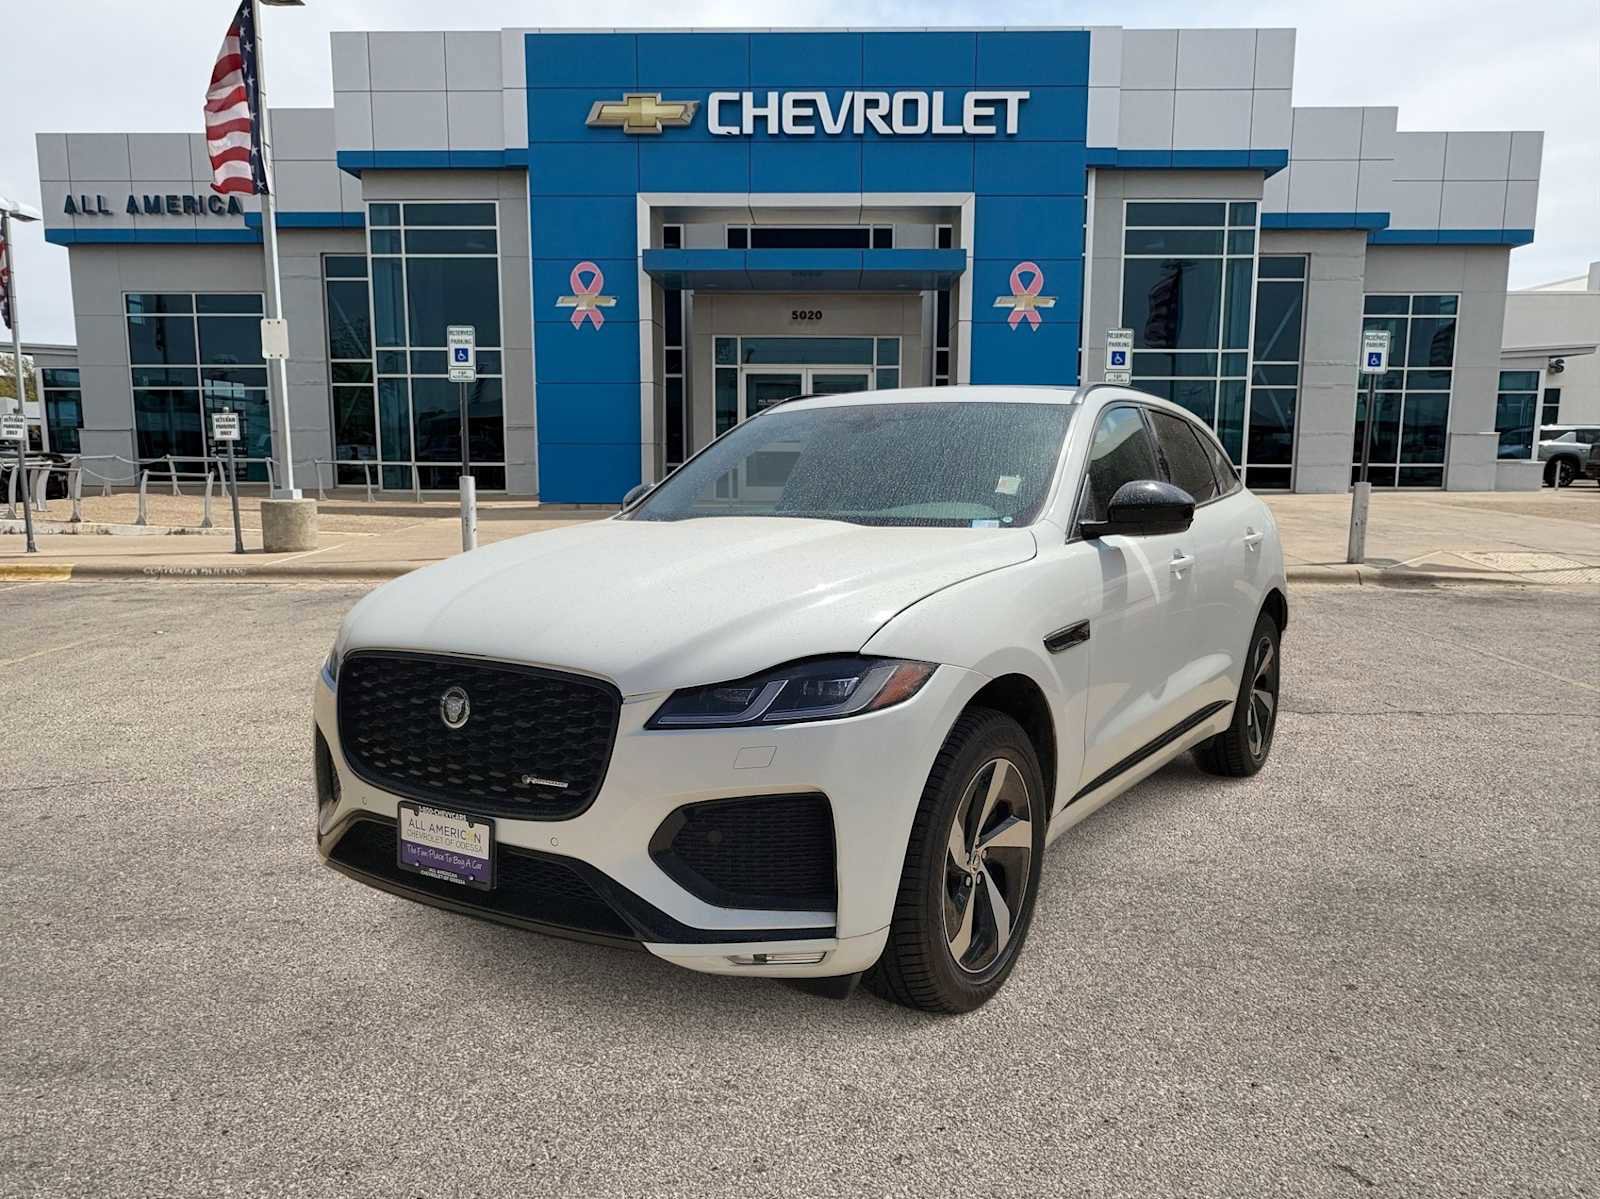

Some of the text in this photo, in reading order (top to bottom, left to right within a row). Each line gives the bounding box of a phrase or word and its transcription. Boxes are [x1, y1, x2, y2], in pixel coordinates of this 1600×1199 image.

[708, 91, 1030, 136] CHEVROLET
[64, 194, 244, 216] ALL AMERICA
[791, 310, 823, 320] 5020
[408, 818, 426, 831] ALL
[406, 829, 444, 843] CHEVROLET
[455, 840, 484, 853] ODESSA
[428, 848, 444, 861] Place
[452, 855, 465, 869] Buy
[471, 860, 482, 870] Car
[437, 869, 458, 878] AMERICAN
